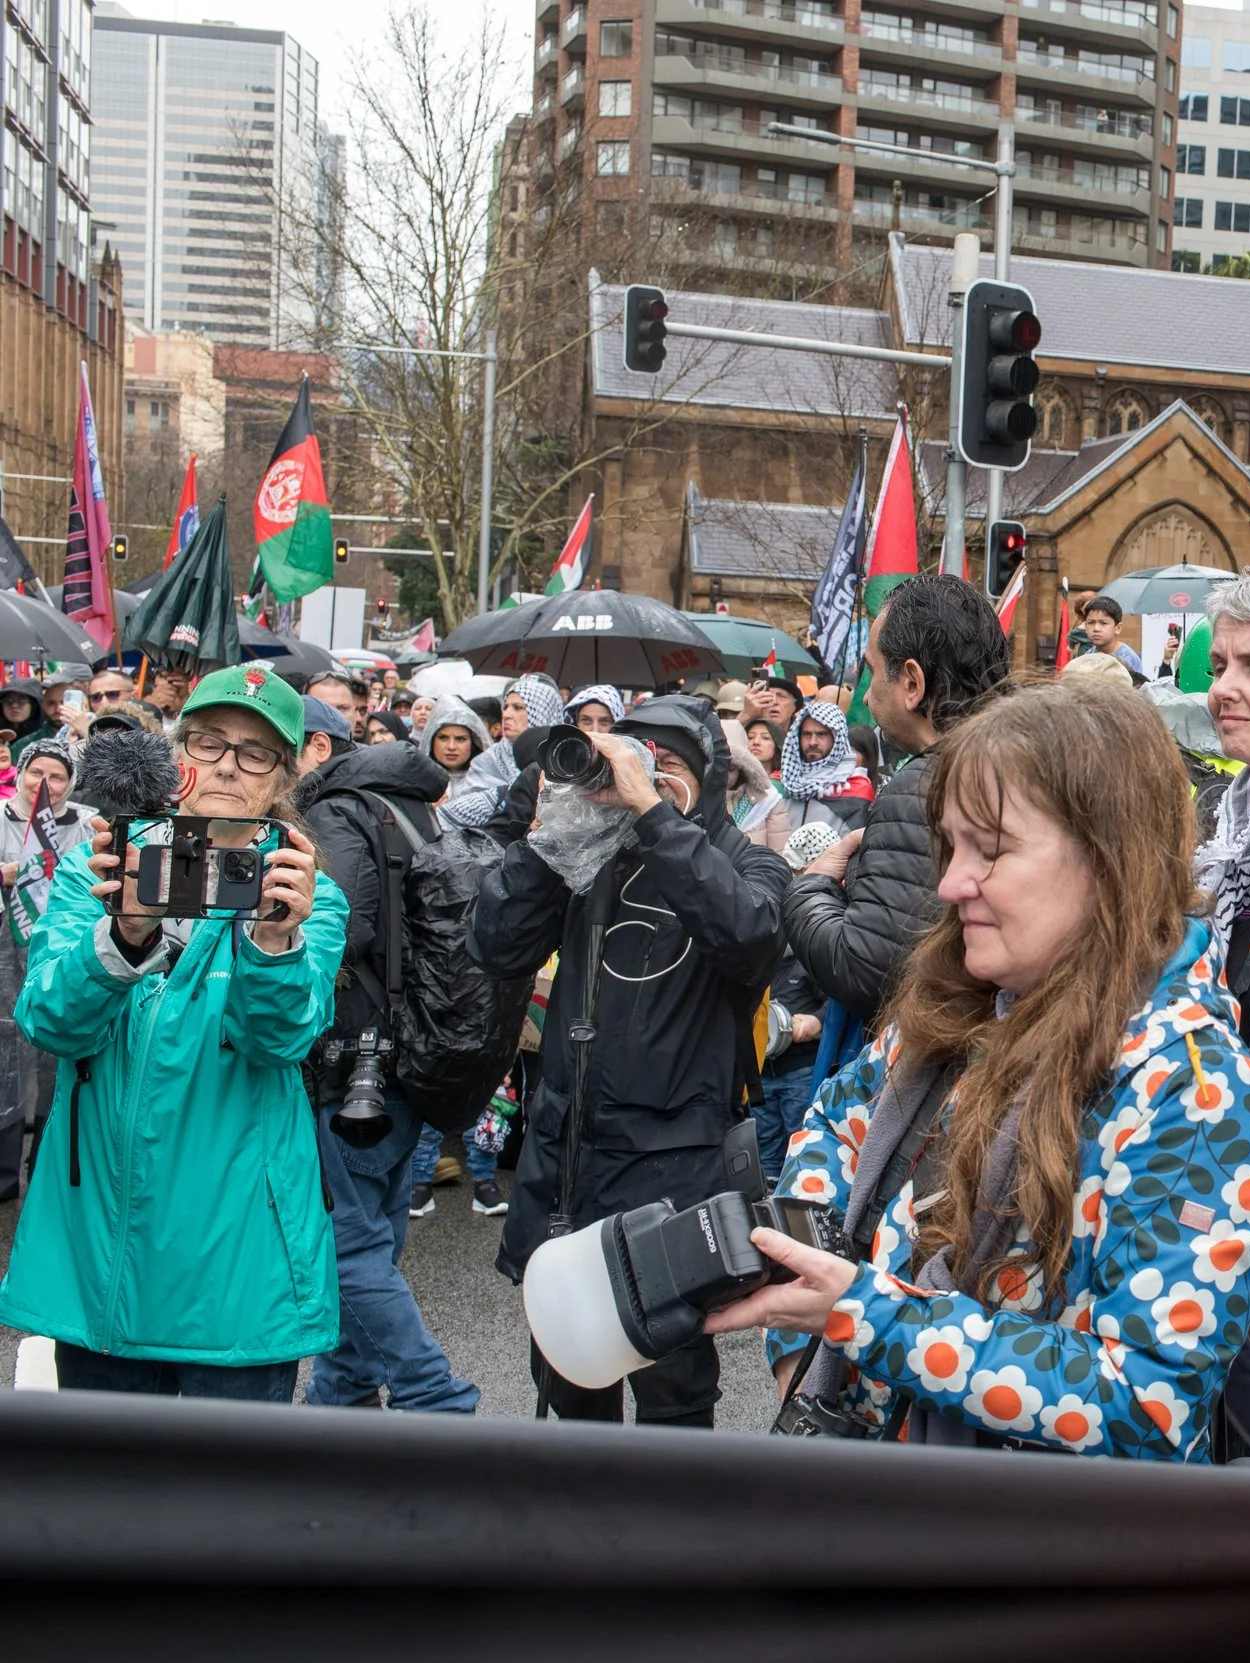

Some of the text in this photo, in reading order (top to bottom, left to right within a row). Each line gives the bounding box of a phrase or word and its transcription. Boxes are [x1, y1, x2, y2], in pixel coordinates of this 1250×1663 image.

[552, 614, 614, 631] ABB
[500, 651, 548, 672] ABB
[659, 648, 700, 673] ABB
